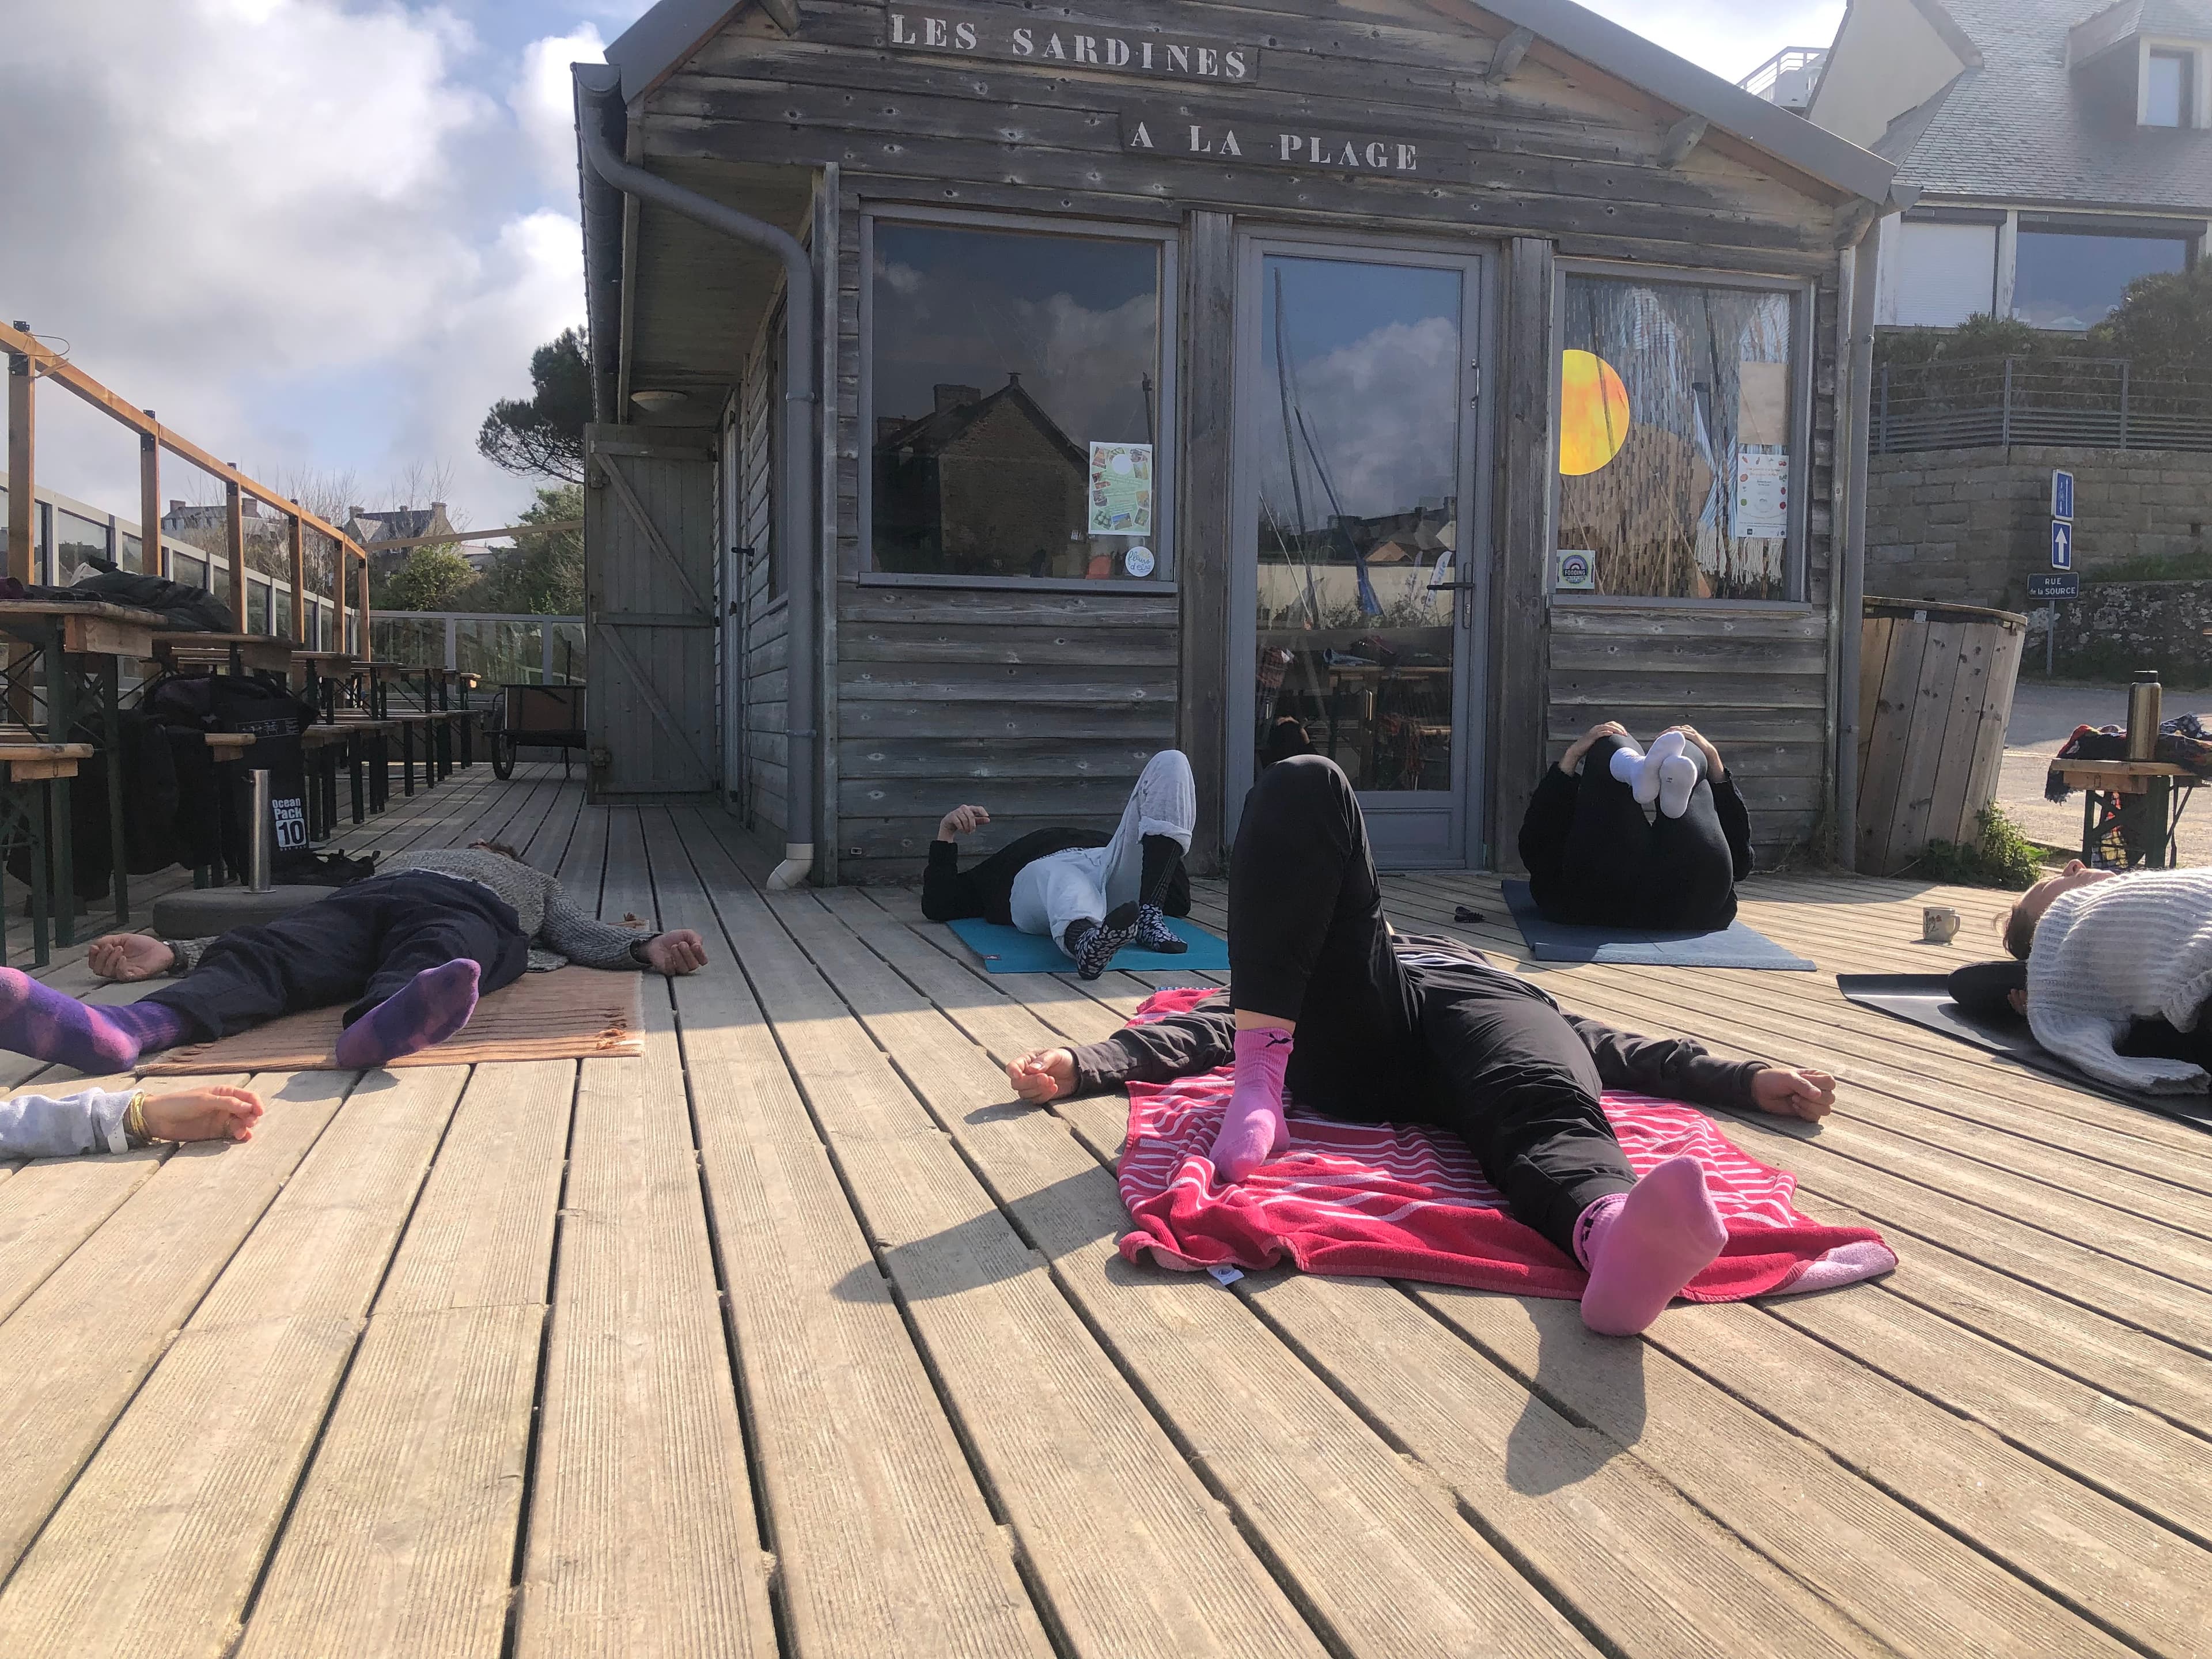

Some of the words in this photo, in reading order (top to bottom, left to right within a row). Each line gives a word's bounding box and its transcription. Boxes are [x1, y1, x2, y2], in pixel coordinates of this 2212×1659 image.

[891, 14, 977, 50] LES
[1012, 28, 1246, 79] SARDINES
[1130, 121, 1154, 148] A
[1189, 124, 1243, 156] LA
[1279, 134, 1416, 170] PLAGE
[2045, 587, 2076, 595] SOURCE
[272, 798, 301, 808] Ocean
[278, 820, 305, 846] 10
